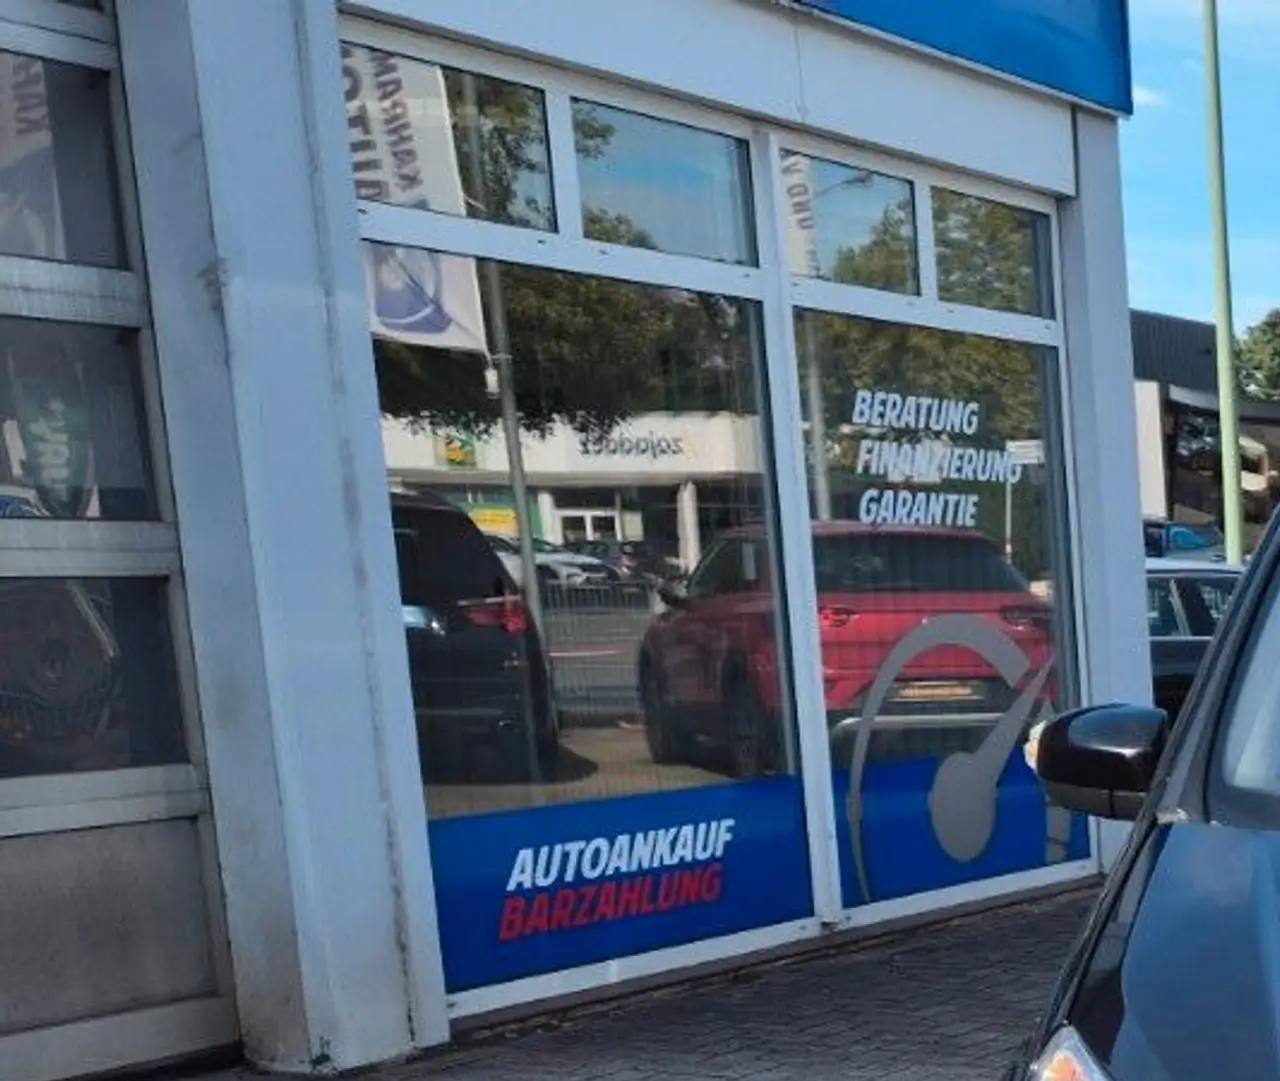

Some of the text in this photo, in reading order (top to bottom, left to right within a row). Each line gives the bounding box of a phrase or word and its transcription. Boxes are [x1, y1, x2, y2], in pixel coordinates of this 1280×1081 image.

[852, 388, 980, 435] BERATUNG
[856, 438, 1024, 484] FINANZIERUNG
[859, 487, 980, 527] GARANTIE
[505, 817, 736, 891] AUTOANKAUF
[499, 862, 723, 941] BARZAHLUNG
